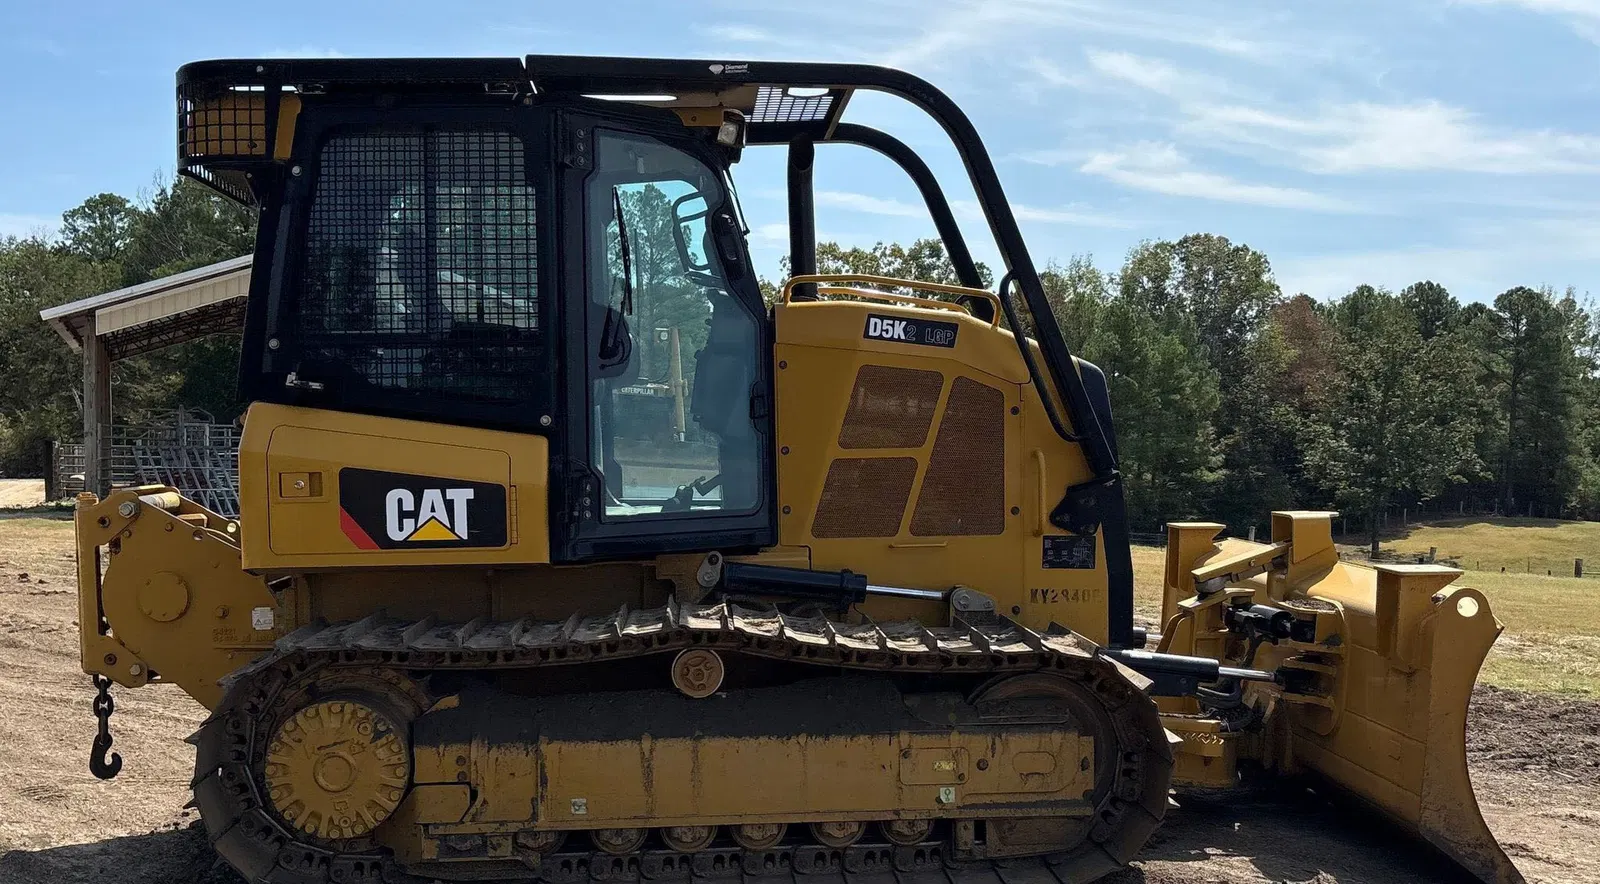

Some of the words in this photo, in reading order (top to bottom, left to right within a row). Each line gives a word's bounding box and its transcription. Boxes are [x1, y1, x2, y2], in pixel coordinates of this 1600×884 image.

[868, 317, 917, 342] D5K2
[924, 327, 955, 345] LGP
[621, 387, 655, 395] CATERPILLAR
[385, 488, 475, 542] CAT
